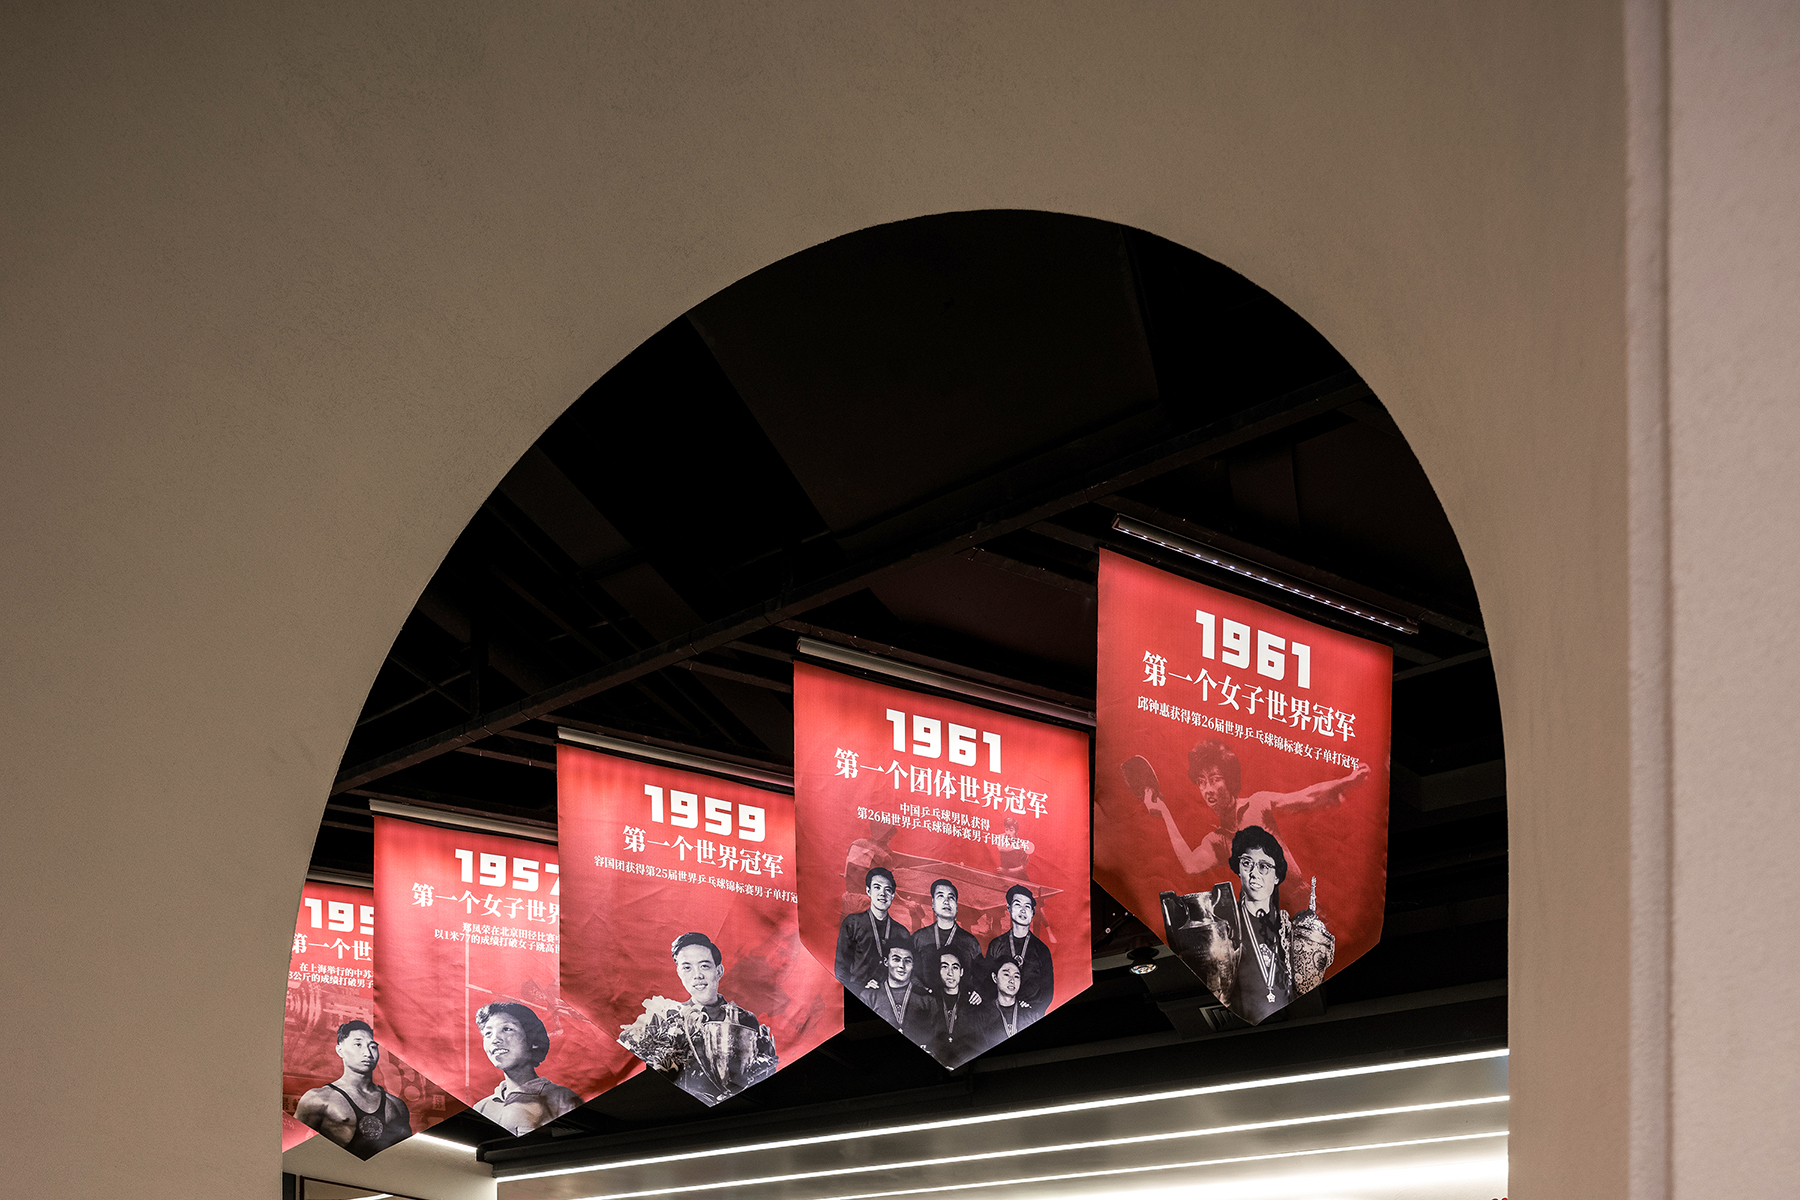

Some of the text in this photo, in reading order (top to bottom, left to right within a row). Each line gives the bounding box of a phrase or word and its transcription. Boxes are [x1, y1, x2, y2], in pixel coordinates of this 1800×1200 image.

[1195, 609, 1311, 689] 1961
[1142, 650, 1356, 742] 第一个女子世界冠军
[886, 708, 1002, 774] 1961
[1137, 695, 1360, 771] 邱钟惠获得第26届世界乒乓球锦标赛女子单打冠军
[644, 783, 766, 842] 1959
[833, 747, 1049, 819] 第一个团体世界冠军
[857, 806, 1030, 851] 第26届世界乒乓球锦标赛男子团体冠军
[900, 802, 990, 832] 中国乒乓球男队获得
[623, 825, 784, 878] 第一个世界冠军
[411, 882, 560, 925] 第一个女子世界
[299, 962, 374, 980] 在上海举行的中苏
